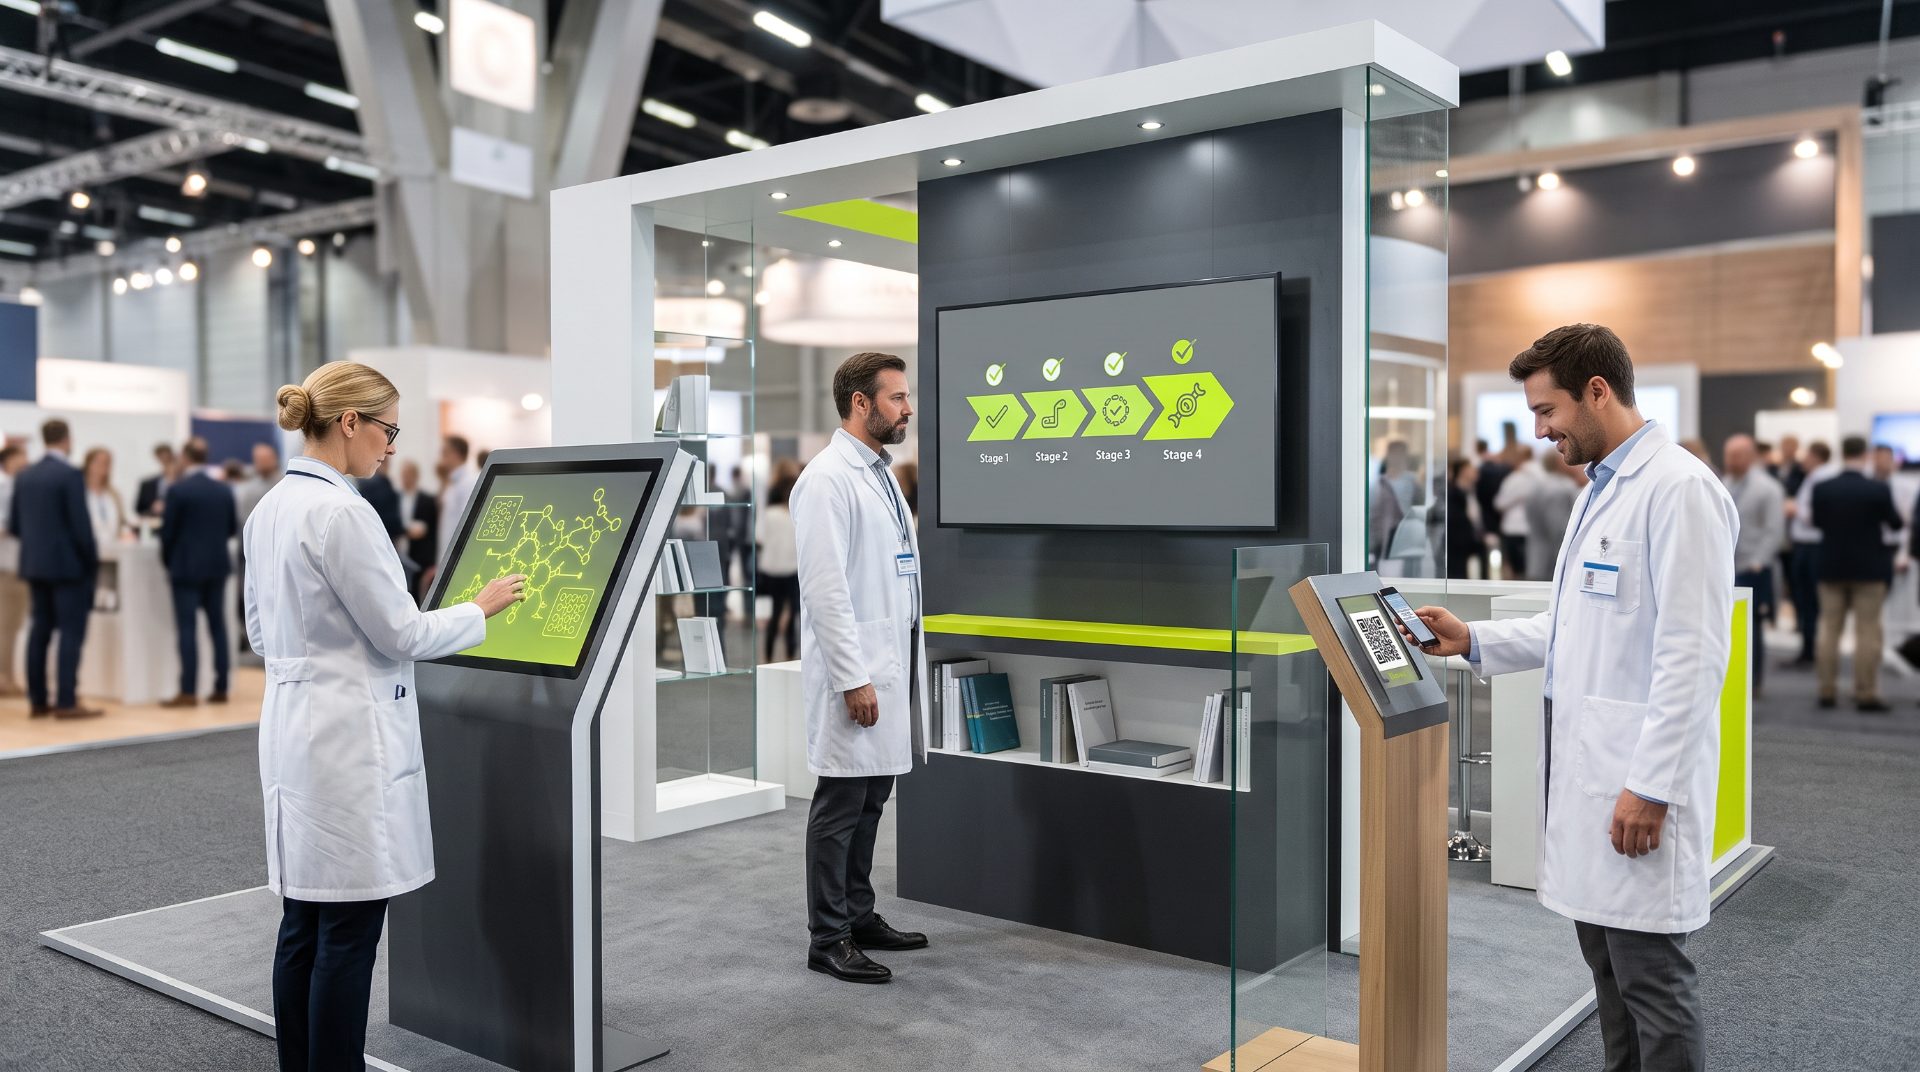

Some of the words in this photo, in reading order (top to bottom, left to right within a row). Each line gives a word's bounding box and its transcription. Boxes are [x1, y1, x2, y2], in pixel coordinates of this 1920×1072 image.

[980, 453, 1004, 465] Stage
[1005, 452, 1009, 463] 1
[1035, 451, 1061, 464] Stage
[1062, 450, 1068, 461] 2
[1095, 449, 1123, 462] Stage
[1124, 449, 1130, 460] 3
[1163, 449, 1193, 462] Stage
[1195, 449, 1202, 459] 4
